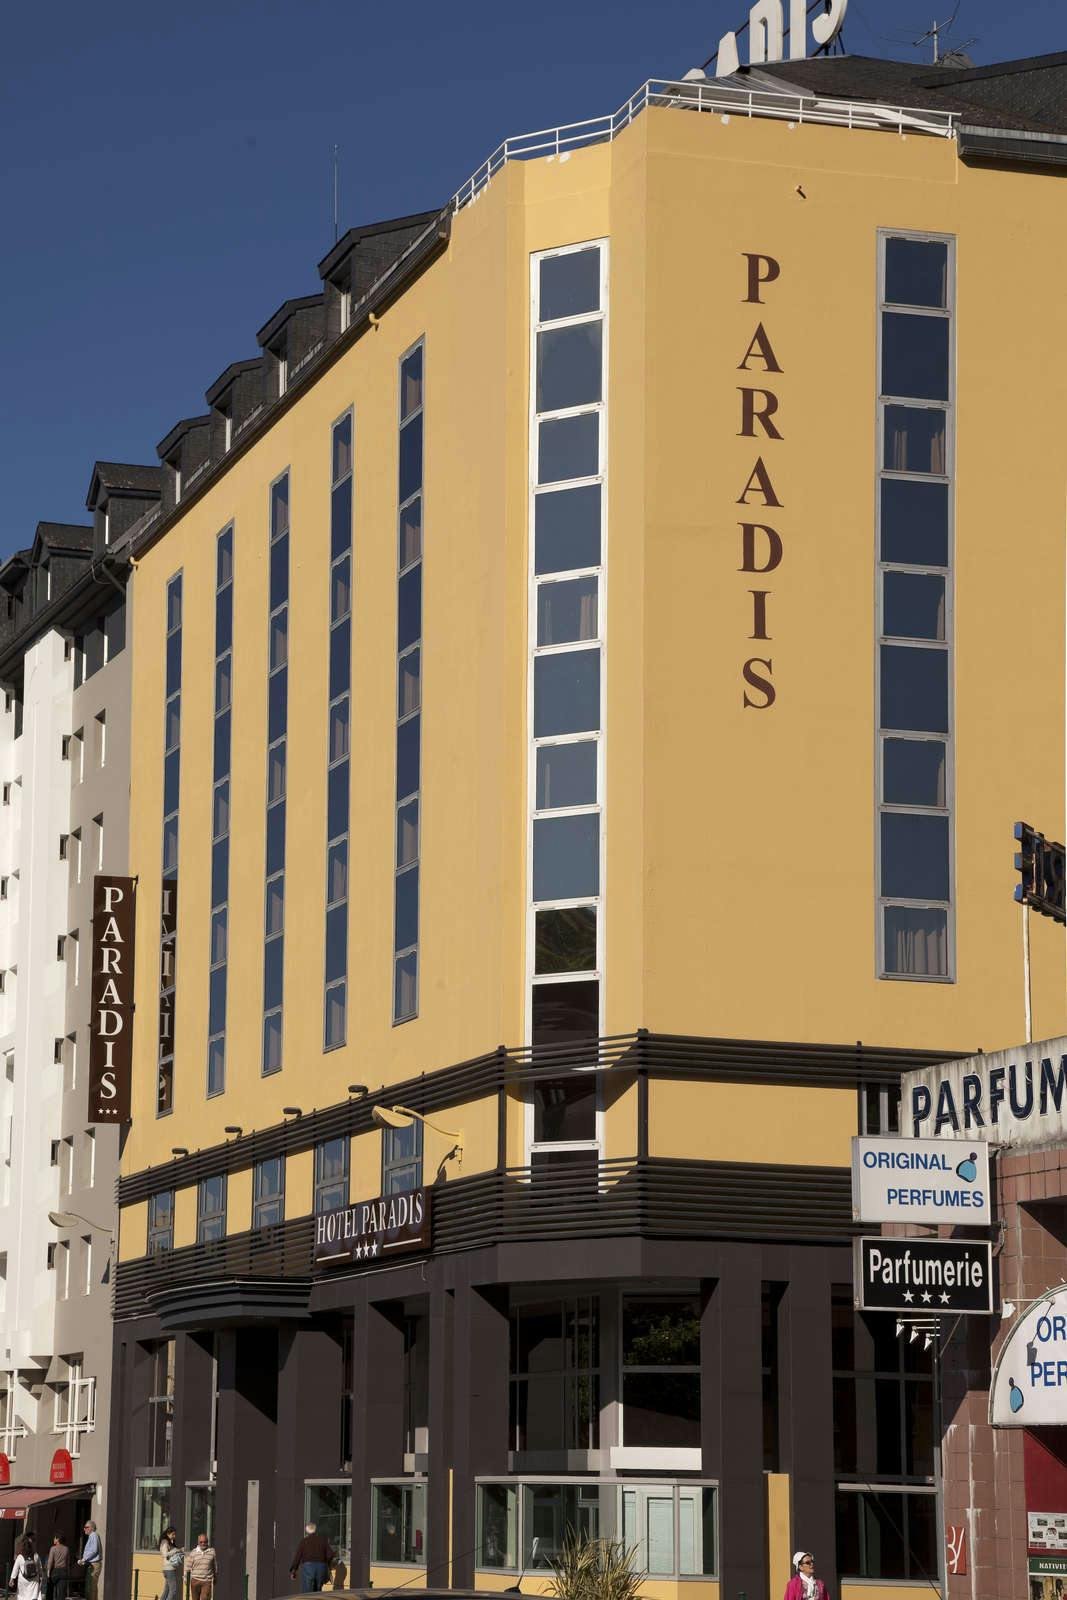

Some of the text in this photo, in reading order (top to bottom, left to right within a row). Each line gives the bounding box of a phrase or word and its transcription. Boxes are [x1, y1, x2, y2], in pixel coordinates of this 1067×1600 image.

[735, 252, 785, 709] PARADIS
[97, 886, 124, 1099] PARADIS
[863, 1151, 952, 1170] ORIGINAL
[316, 1192, 423, 1245] HOTEL PARADIS
[887, 1188, 984, 1208] PERFUMES
[869, 1248, 983, 1288] Parfumerie
